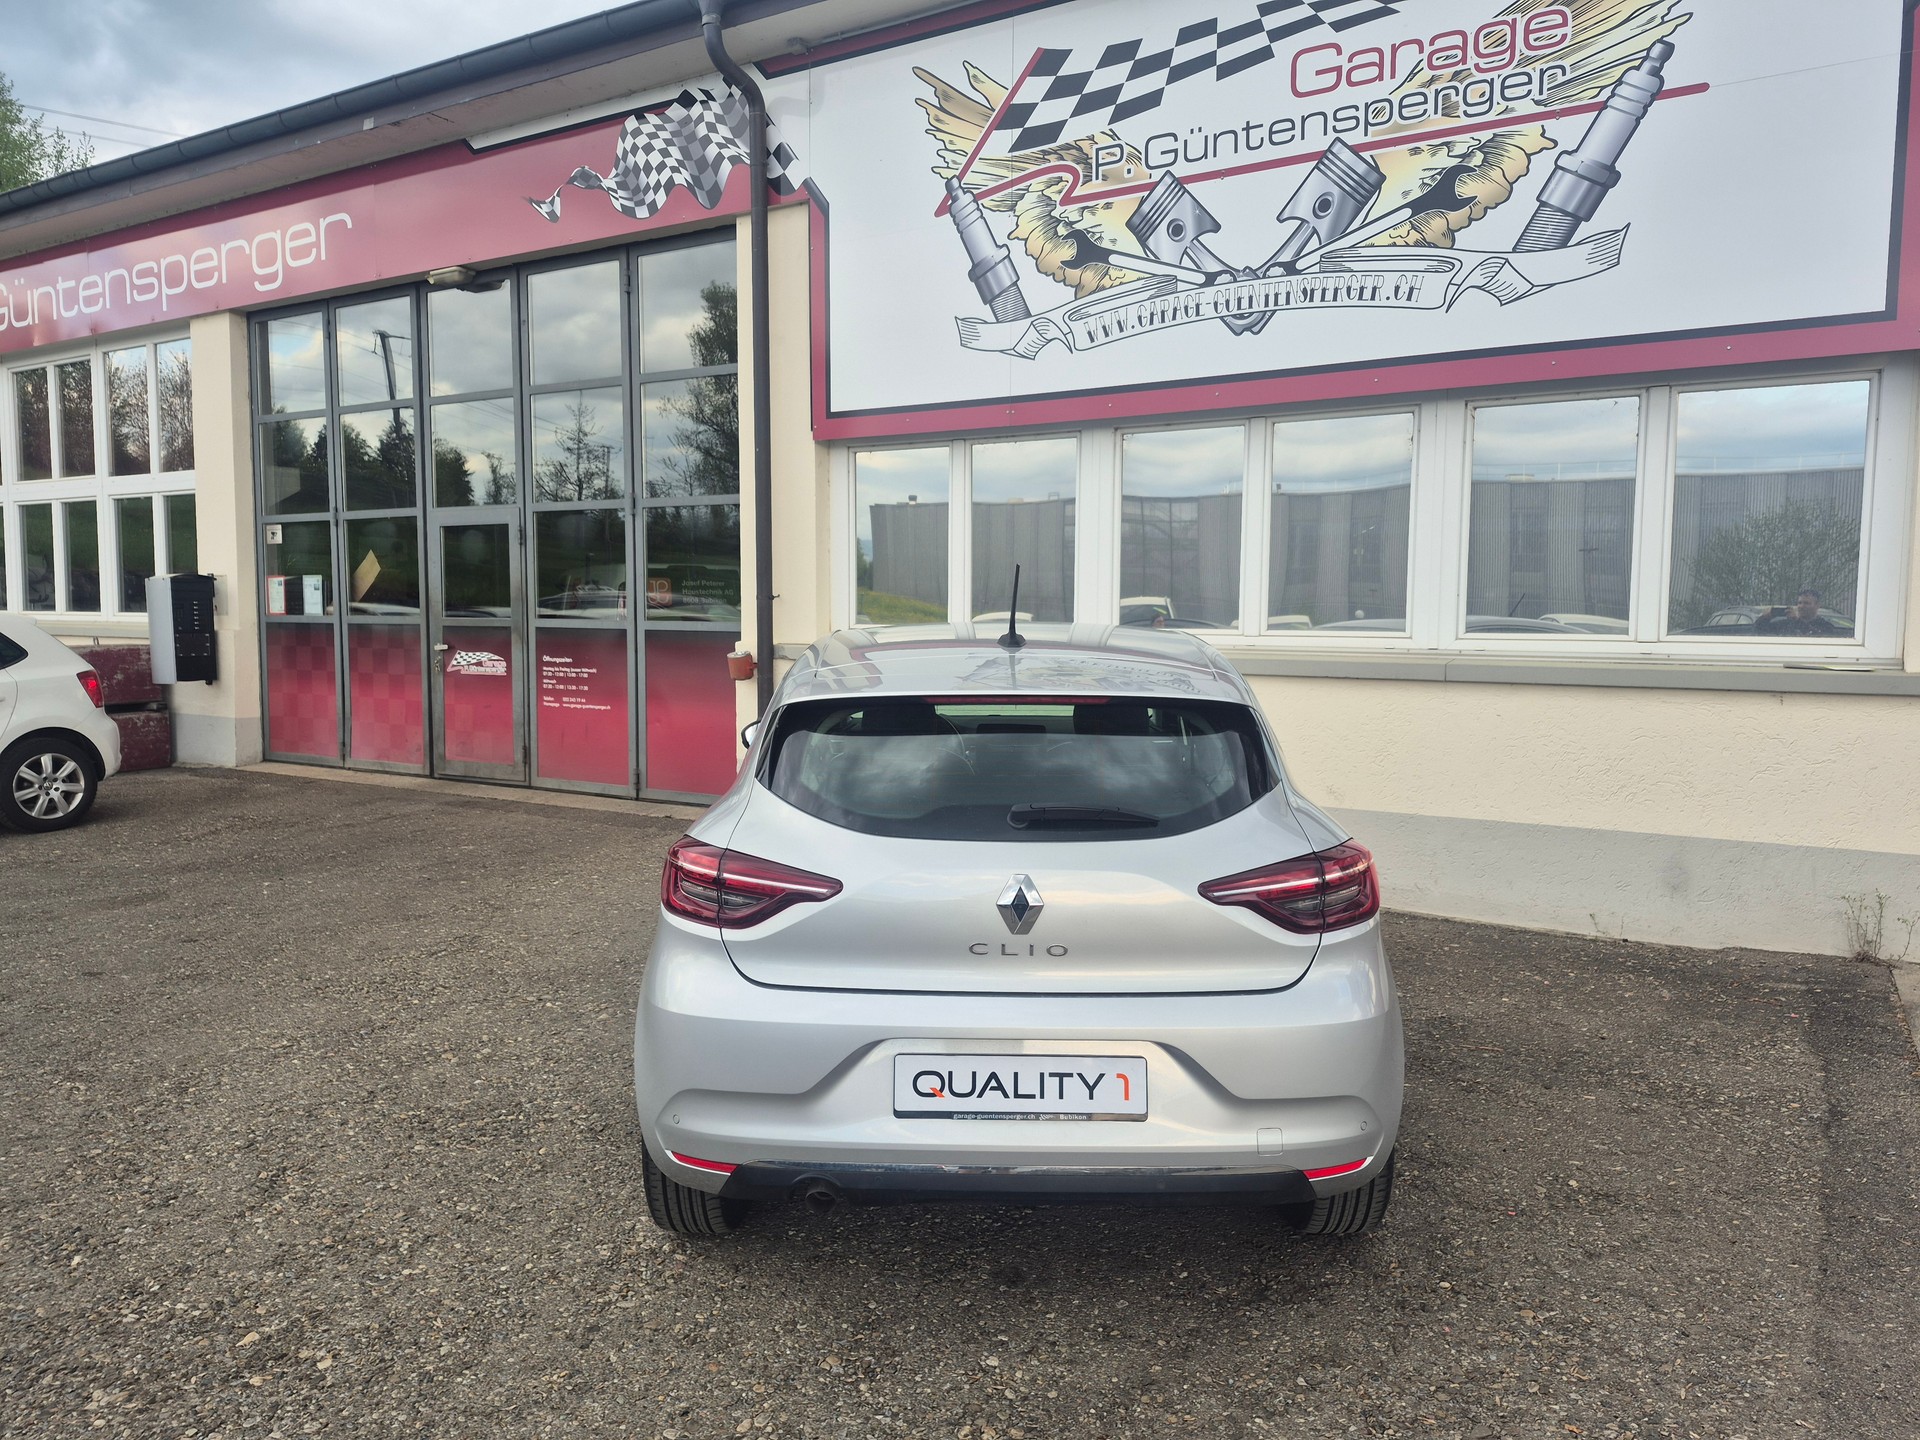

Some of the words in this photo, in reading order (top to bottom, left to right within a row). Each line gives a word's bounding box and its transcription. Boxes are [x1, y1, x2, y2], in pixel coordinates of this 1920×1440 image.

[1290, 8, 1569, 98] Garage
[1092, 144, 1131, 181] P.
[1145, 64, 1567, 171] Güntensperger
[1083, 273, 1426, 344] WWW.GARAGE-GUENTENSPERGER.CH
[968, 943, 1068, 956] CLIO
[912, 1070, 1106, 1100] QUALITY
[1116, 1073, 1130, 1100] 1
